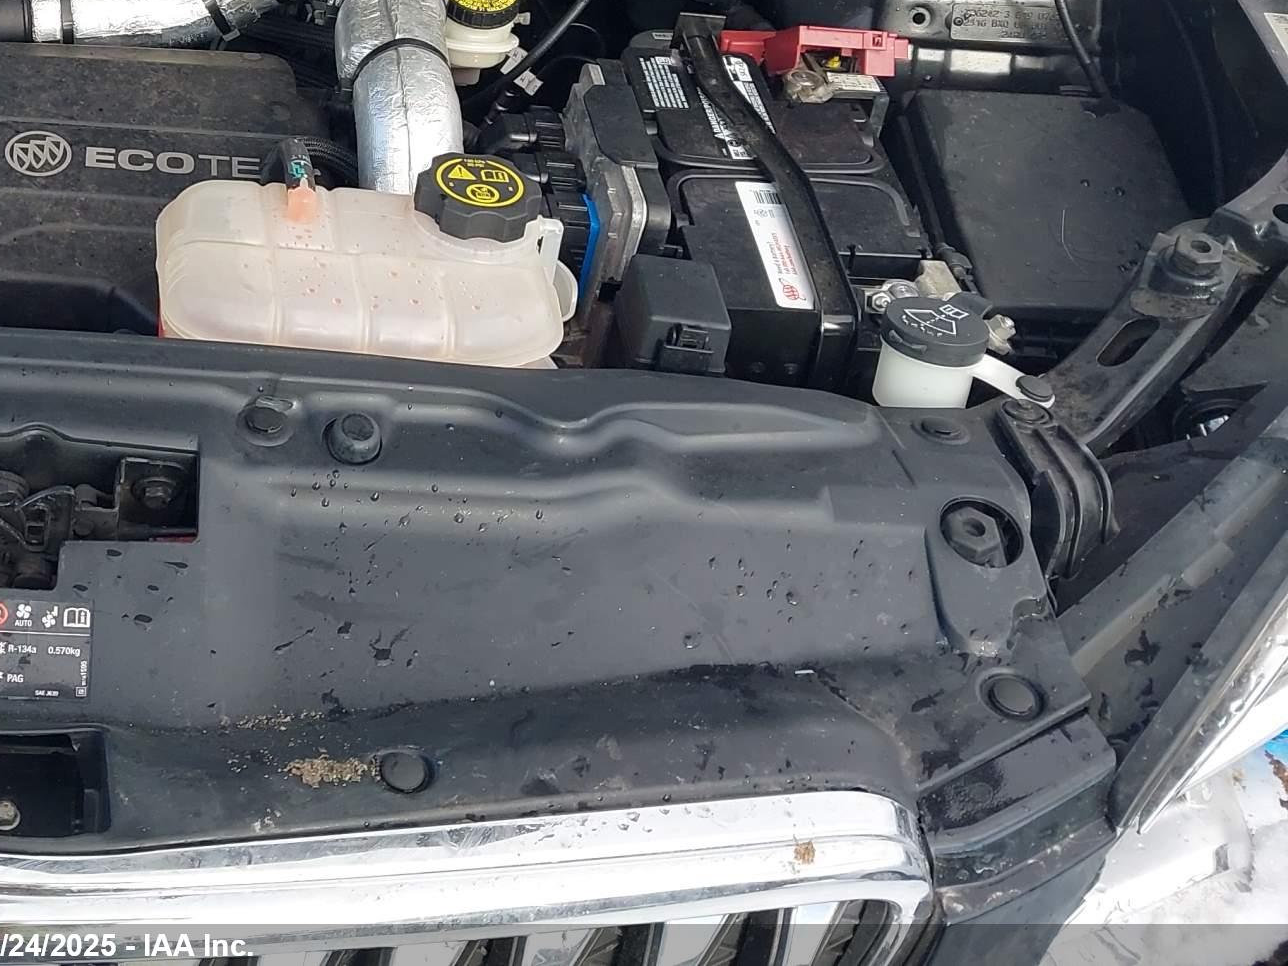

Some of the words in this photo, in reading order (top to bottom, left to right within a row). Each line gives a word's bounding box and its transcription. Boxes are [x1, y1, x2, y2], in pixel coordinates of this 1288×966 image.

[86, 146, 262, 180] ECOTE
[14, 619, 33, 627] AUTO
[8, 644, 37, 654] R-134a
[47, 646, 81, 657] 0.570kg
[6, 674, 24, 683] PAG
